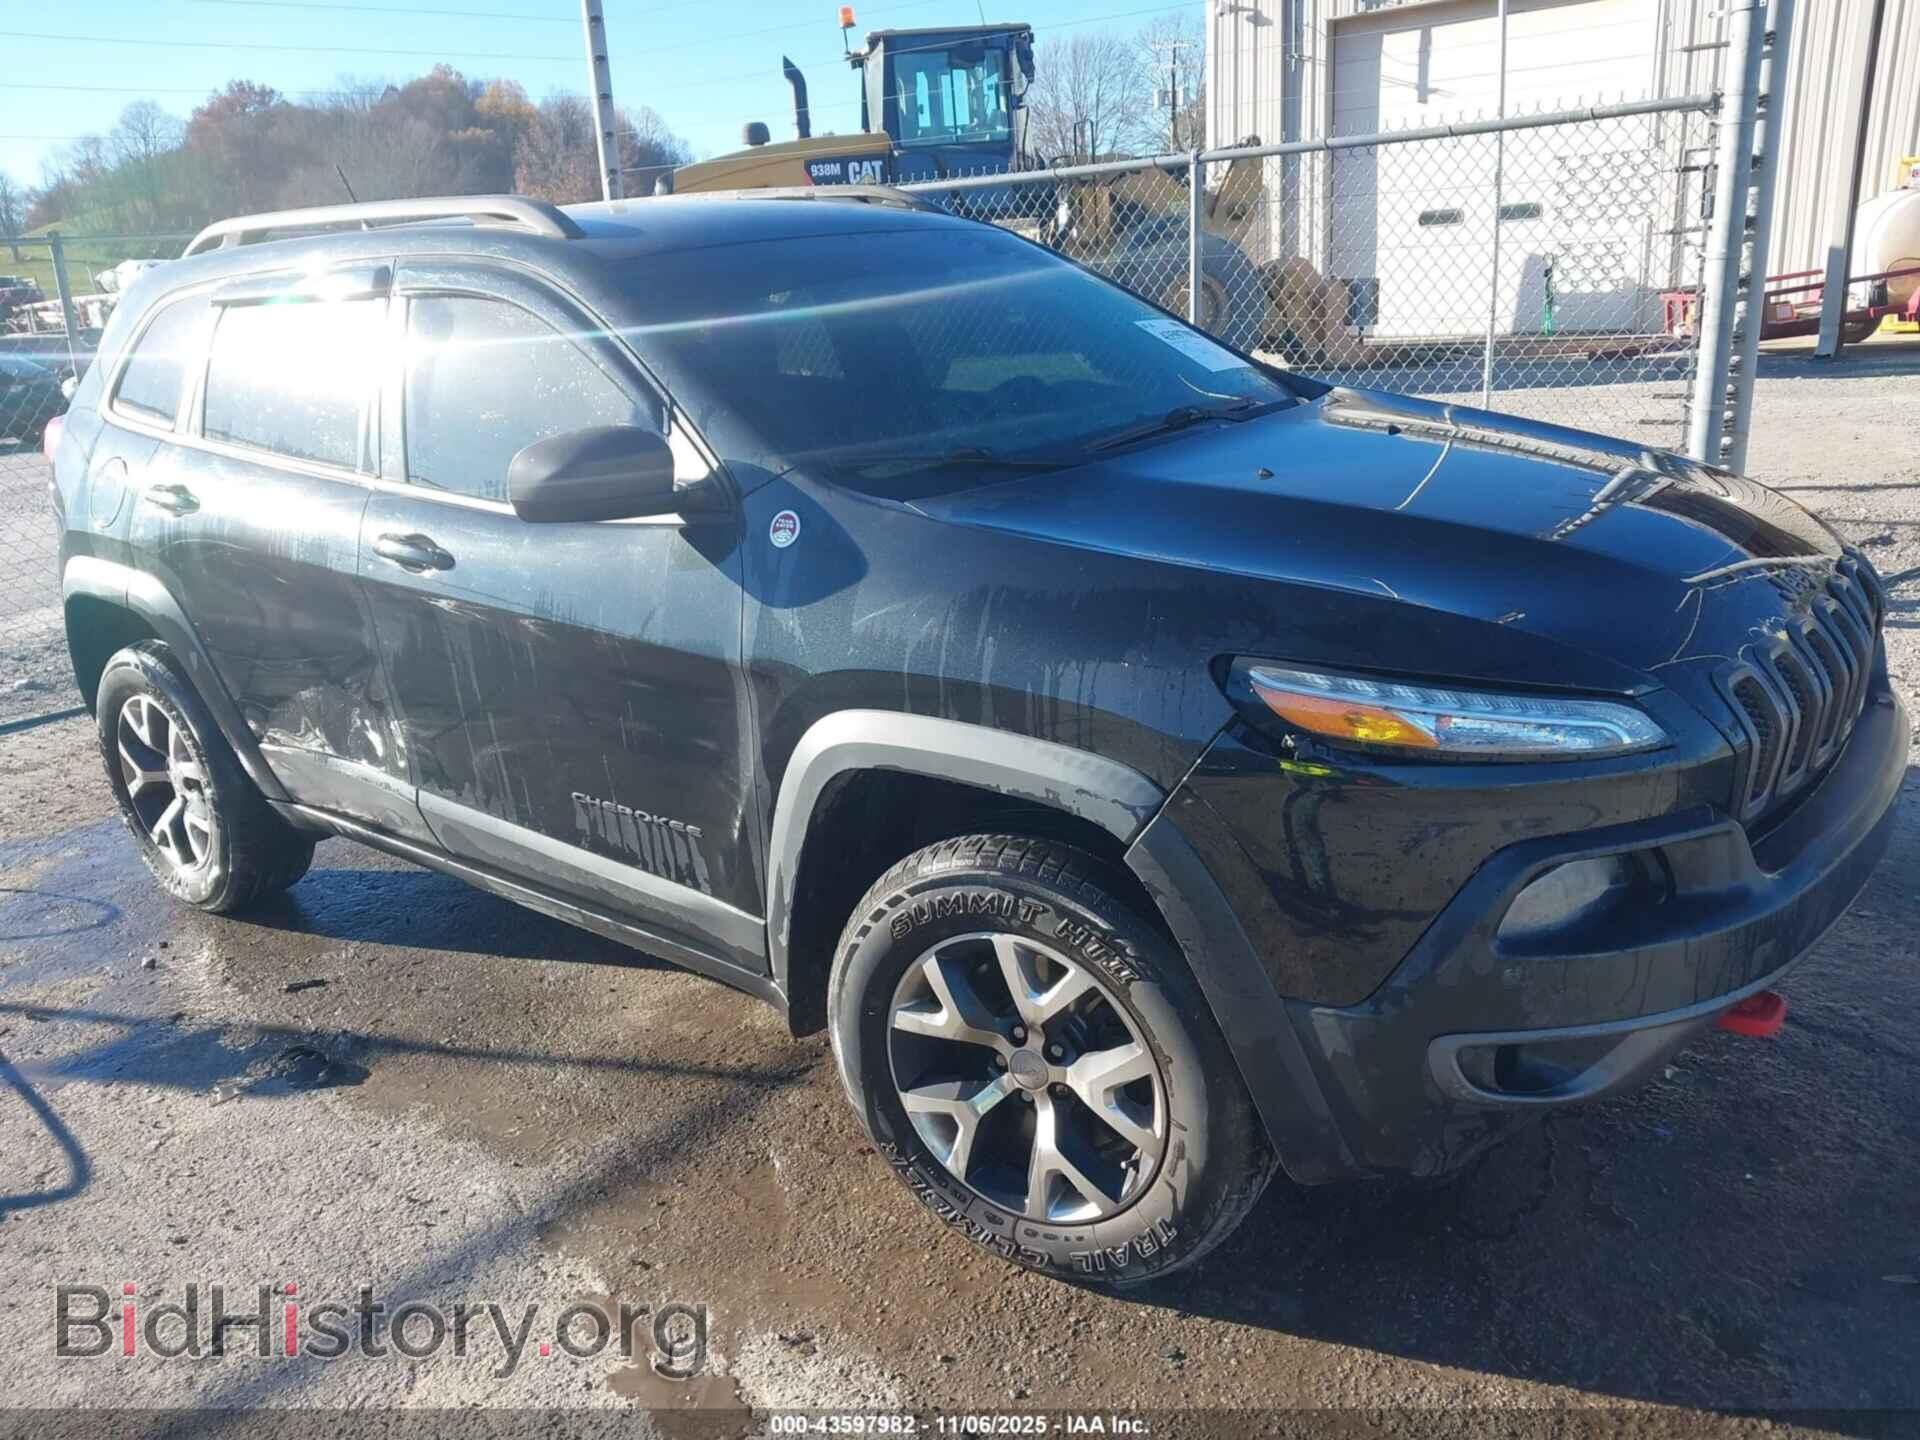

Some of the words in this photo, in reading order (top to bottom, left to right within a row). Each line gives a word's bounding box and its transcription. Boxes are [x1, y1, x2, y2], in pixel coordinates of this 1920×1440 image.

[811, 163, 841, 177] 938M
[848, 161, 883, 185] CAT
[571, 792, 704, 838] CHEROKEE
[888, 891, 1044, 940] SUMMIT
[1070, 1217, 1178, 1273] TRAIL
